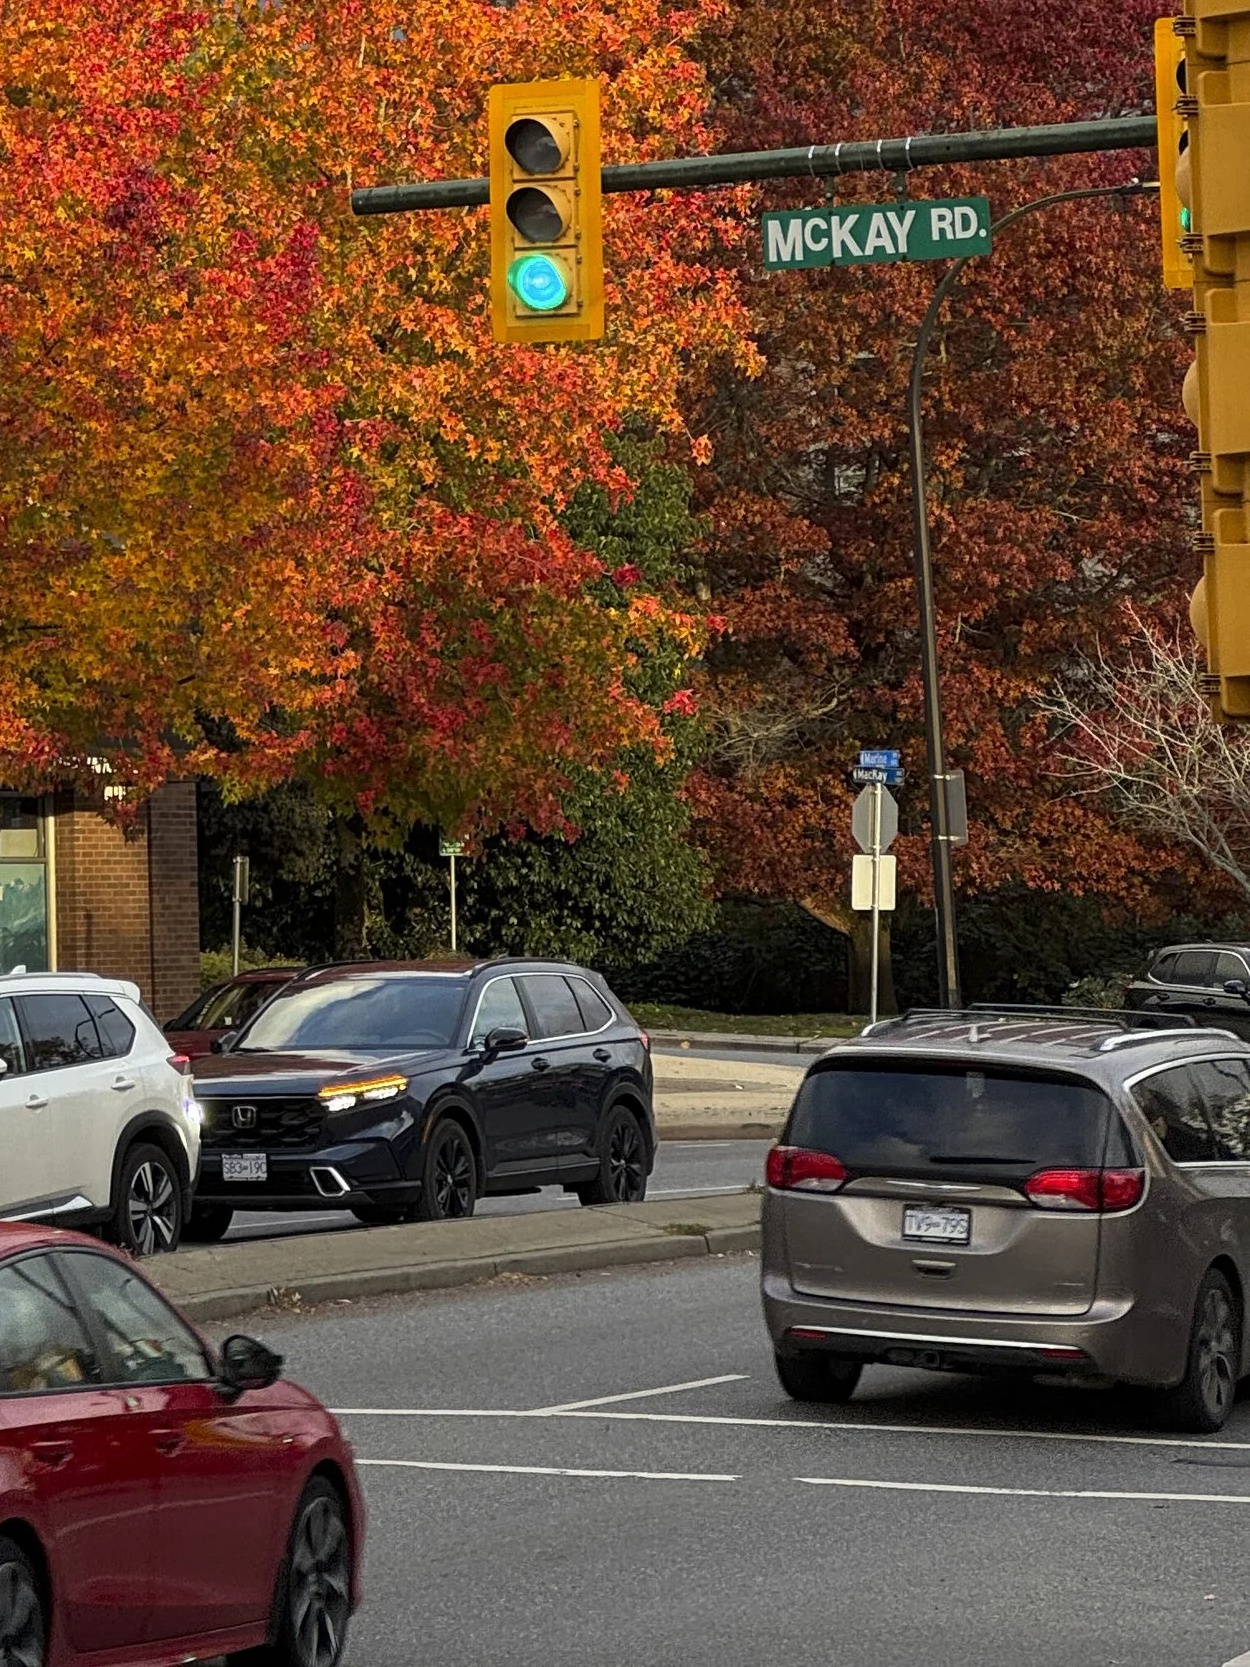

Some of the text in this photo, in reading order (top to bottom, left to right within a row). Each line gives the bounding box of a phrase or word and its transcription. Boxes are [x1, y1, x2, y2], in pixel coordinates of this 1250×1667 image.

[931, 206, 987, 241] RD.
[864, 752, 887, 765] Marine
[858, 768, 888, 784] MacKay
